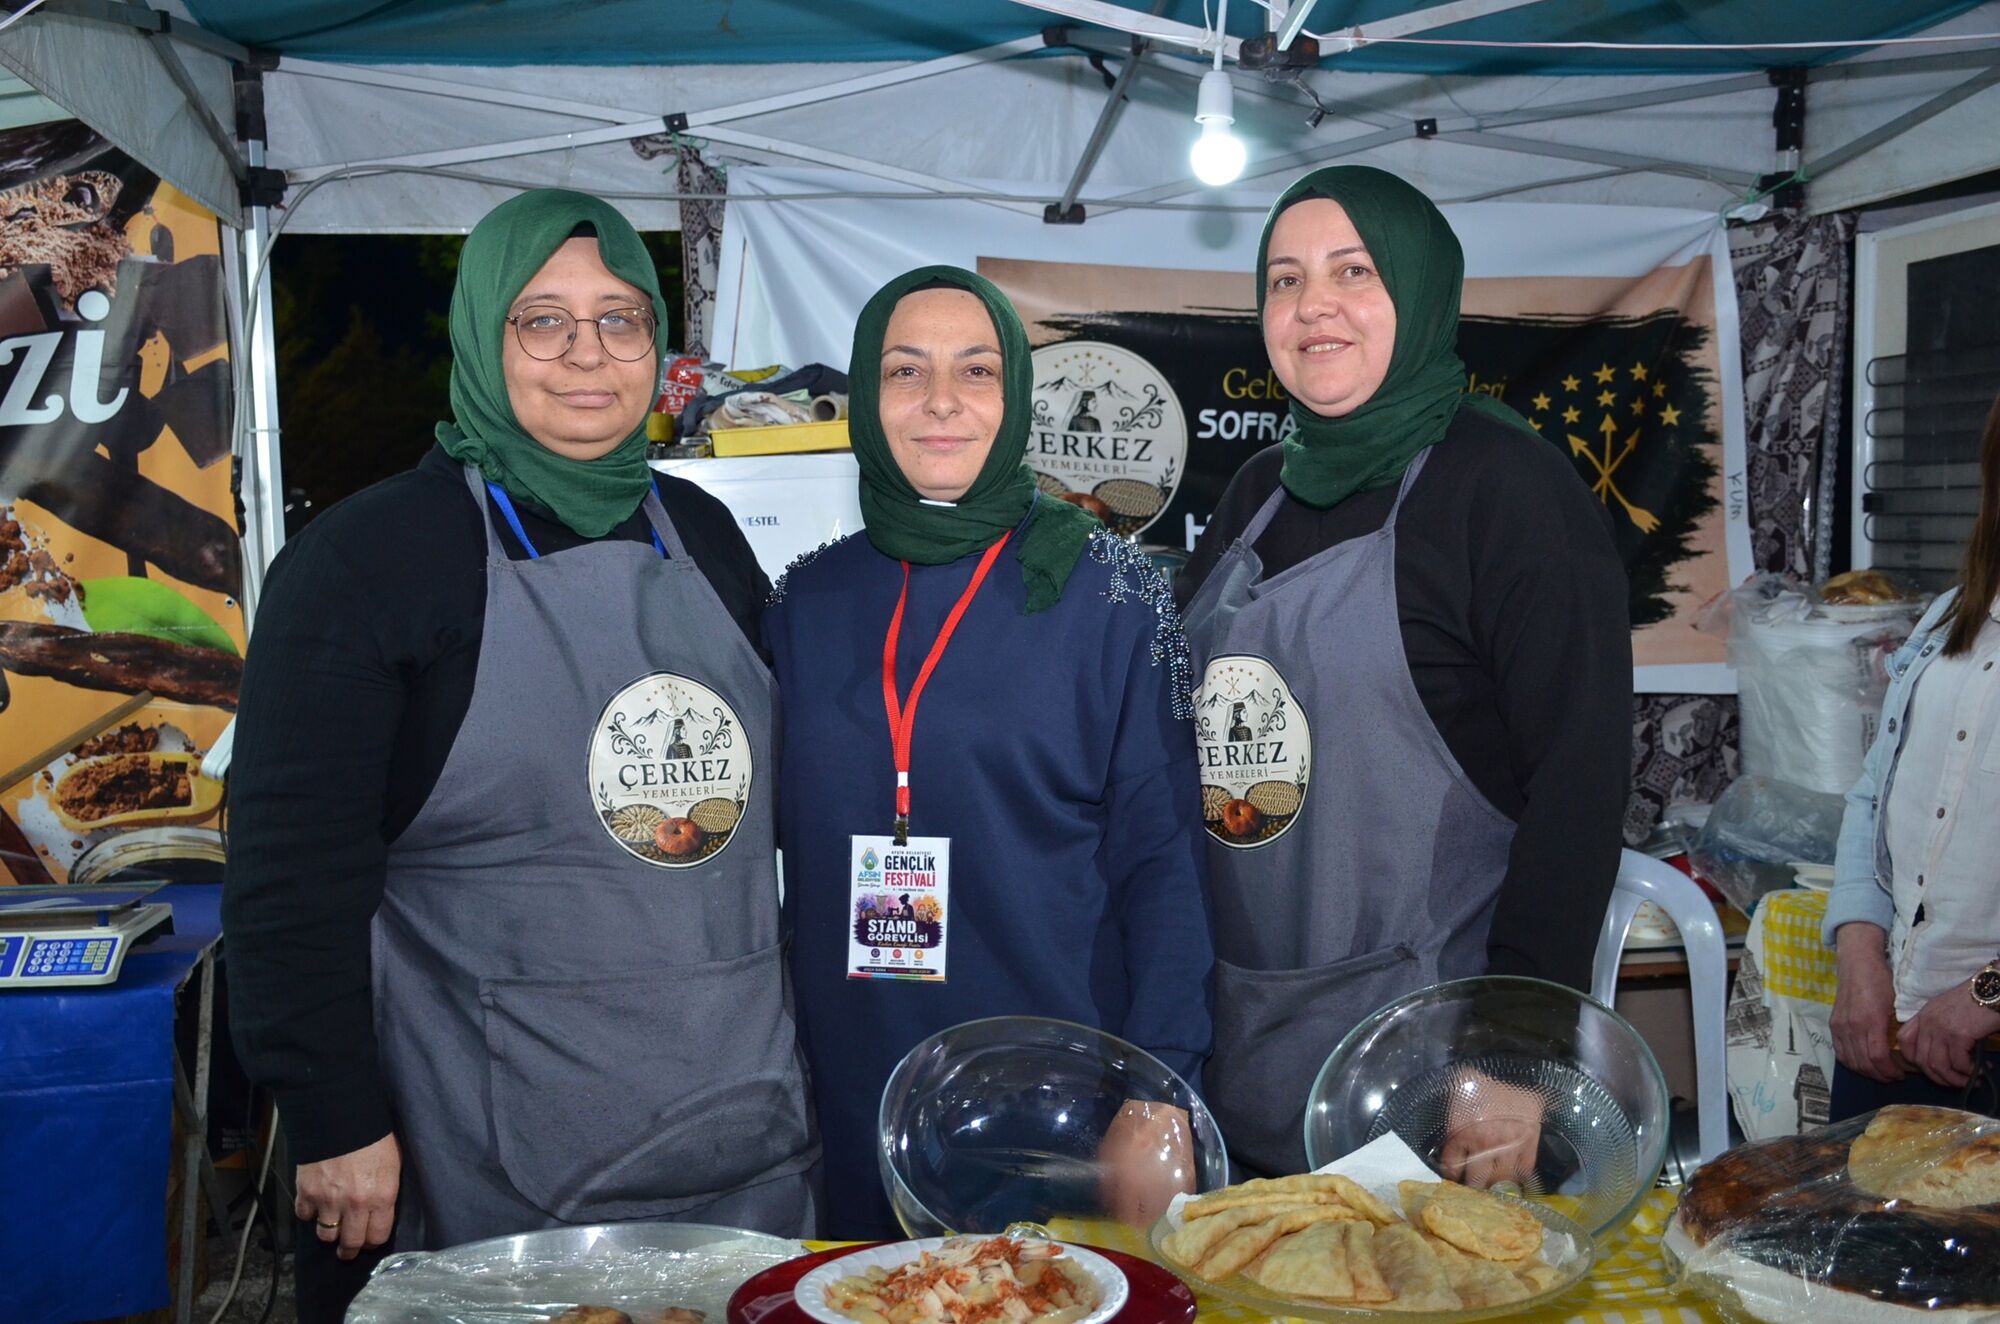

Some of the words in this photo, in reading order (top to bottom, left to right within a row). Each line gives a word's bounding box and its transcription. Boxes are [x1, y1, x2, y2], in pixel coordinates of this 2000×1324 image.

[1040, 459, 1127, 475] YEMEKLERİ
[741, 515, 780, 526] VESTEL
[618, 758, 732, 791] ÇERKEZ
[1209, 767, 1268, 780] YEMEKLERİ
[642, 785, 715, 799] YEMEKLERİ
[885, 854, 936, 874] GENÇLİK
[885, 871, 936, 887] FESTİVALİ
[868, 919, 917, 934] STAND
[867, 932, 929, 943] GÖREVLİSİ
